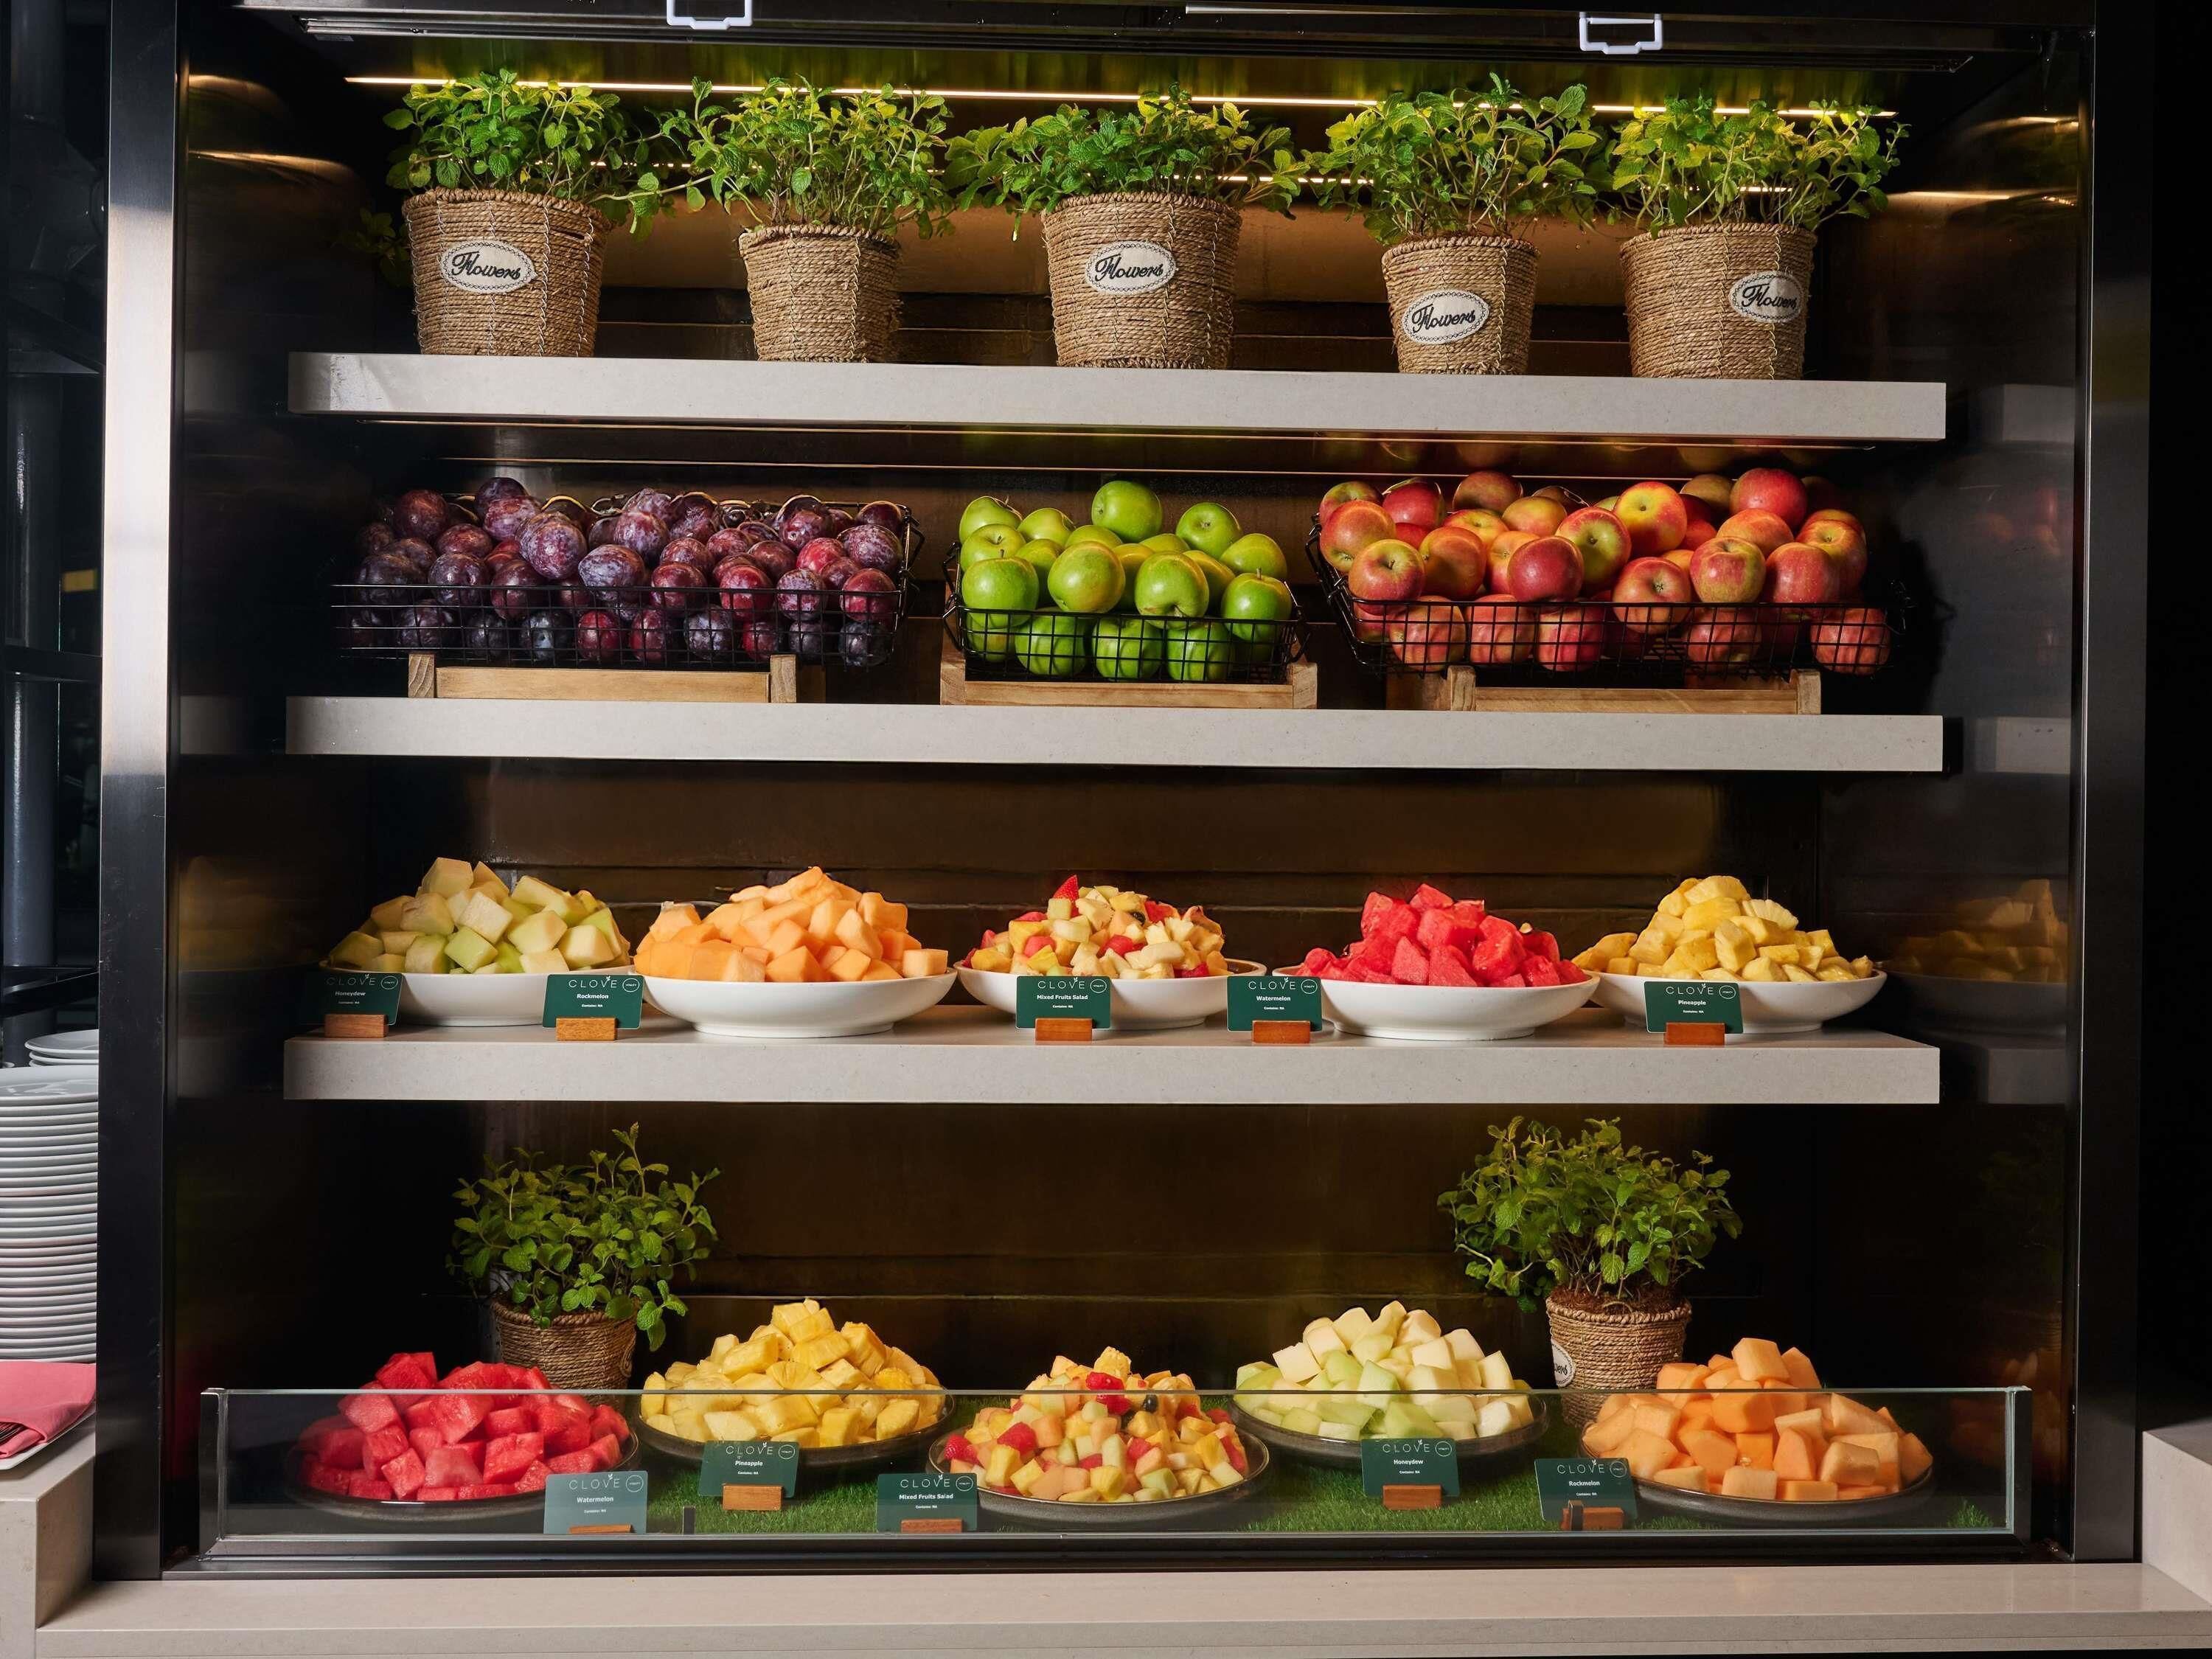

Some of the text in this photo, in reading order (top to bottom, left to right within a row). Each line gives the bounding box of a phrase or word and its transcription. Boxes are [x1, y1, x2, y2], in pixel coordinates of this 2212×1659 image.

[451, 251, 521, 280] Flowers
[1095, 253, 1164, 282] Flowers
[1411, 303, 1476, 333] Flowers
[327, 975, 376, 986] CLOVE
[568, 977, 618, 988] CLOVE
[1037, 978, 1085, 990] CLOVE
[1248, 979, 1296, 990] CLOVE
[1666, 984, 1714, 995] CLOVE
[726, 1444, 773, 1455] CLOVE
[1382, 1442, 1430, 1453] CLOVE
[1557, 1462, 1605, 1474] CLOVE
[568, 1476, 620, 1490] CLOVE
[900, 1477, 950, 1488] CLOVE
